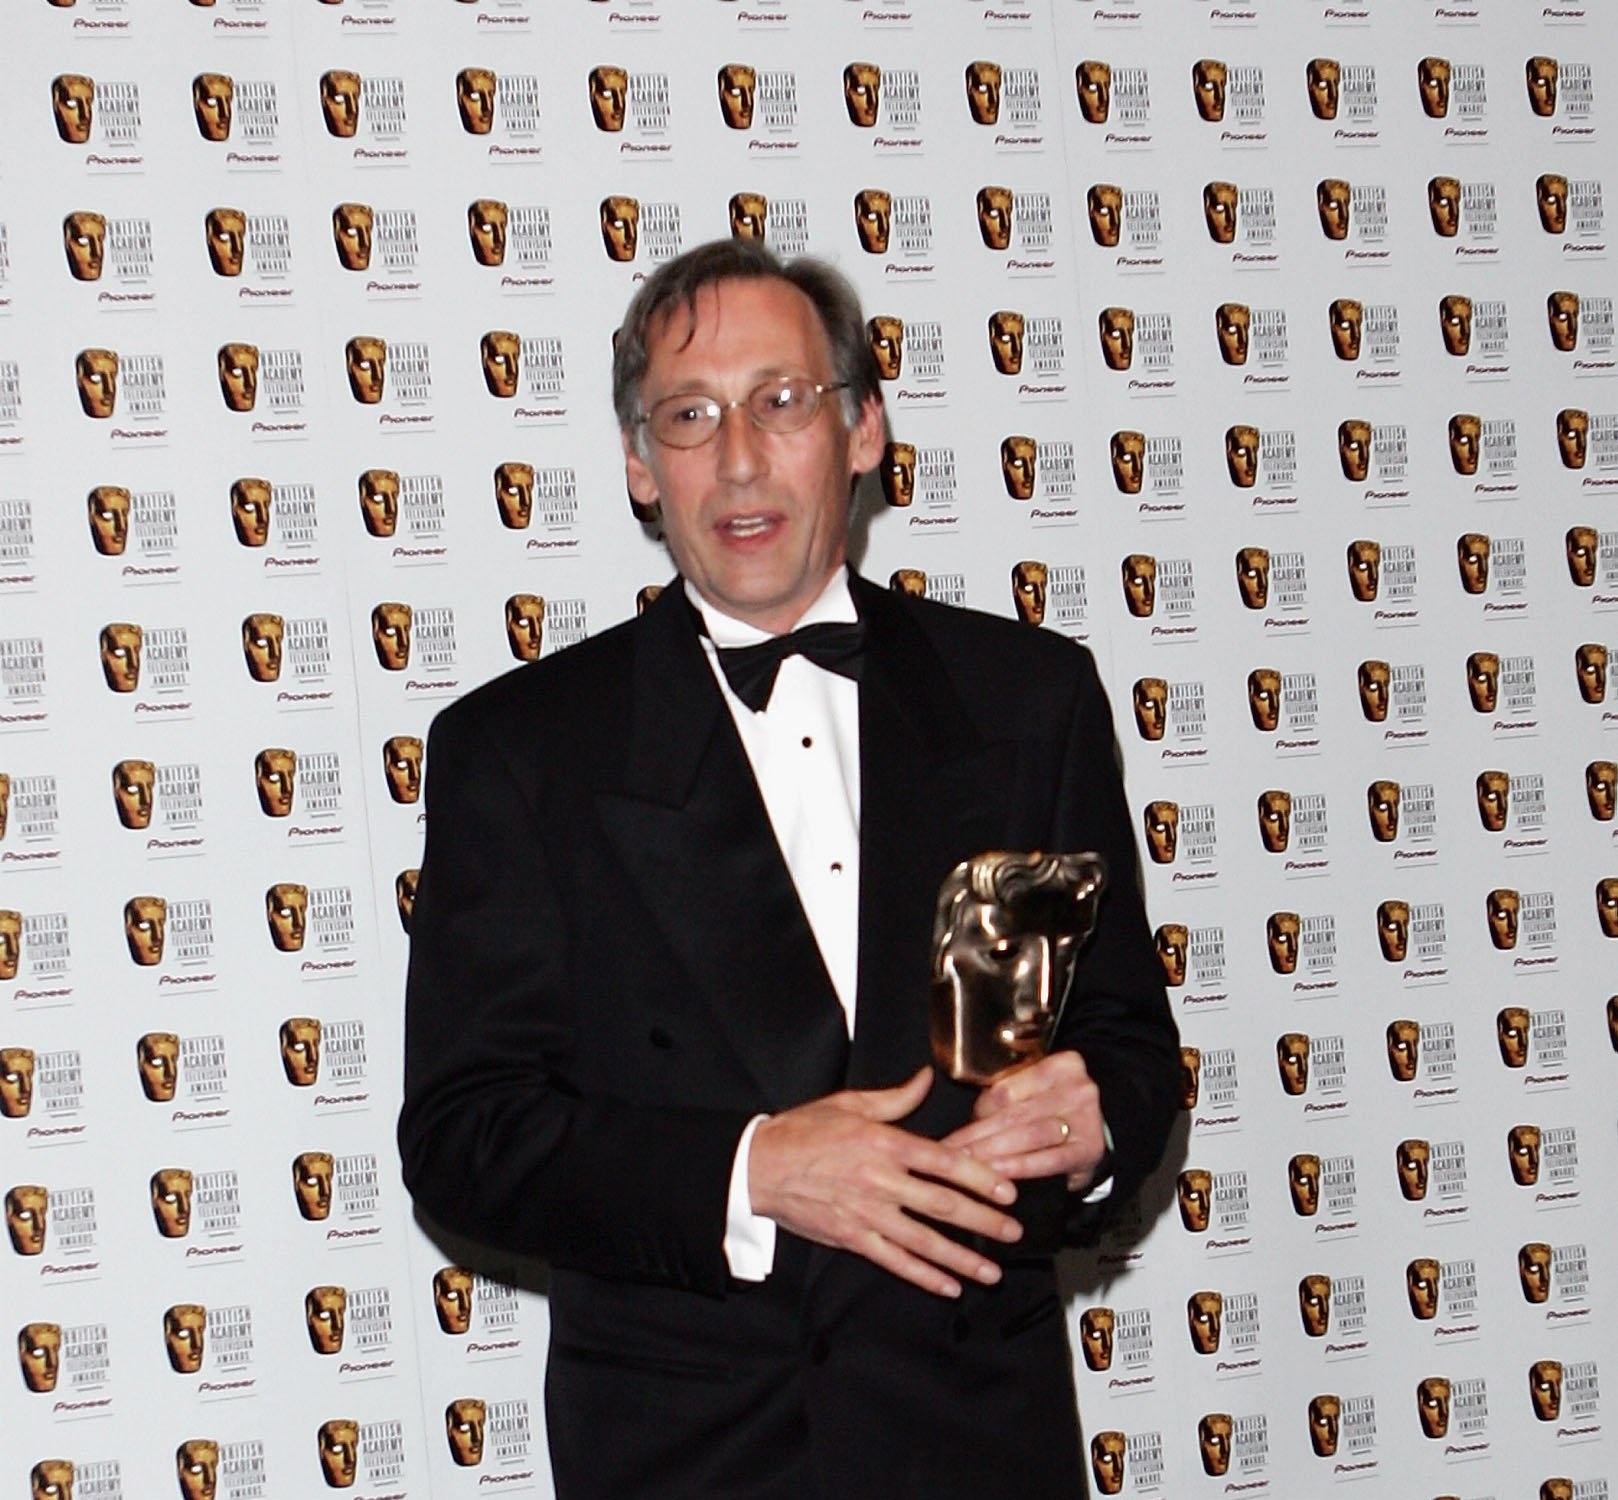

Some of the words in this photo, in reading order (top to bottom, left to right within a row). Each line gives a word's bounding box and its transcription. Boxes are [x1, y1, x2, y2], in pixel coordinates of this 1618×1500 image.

[362, 80, 404, 94] BRITISH
[629, 75, 668, 89] BRITISH
[96, 84, 139, 98] BRITISH
[631, 90, 668, 102] ACADEMY
[98, 99, 139, 112] ACADEMY
[364, 94, 404, 107] ACADEMY
[509, 209, 549, 223] BRITISH
[248, 218, 289, 232] BRITISH
[511, 223, 550, 236] ACADEMY
[250, 232, 289, 245] ACADEMY
[522, 339, 562, 354] BRITISH
[260, 352, 302, 366] BRITISH
[524, 354, 562, 367] ACADEMY
[262, 367, 302, 380] ACADEMY
[401, 477, 442, 492] BRITISH
[132, 493, 175, 509] BRITISH
[403, 492, 443, 506] ACADEMY
[134, 509, 175, 523] ACADEMY
[285, 620, 328, 636] BRITISH
[288, 635, 328, 650] ACADEMY
[157, 765, 200, 782] BRITISH
[159, 781, 200, 796] ACADEMY
[322, 1022, 364, 1039] BRITISH
[325, 1037, 364, 1053] ACADEMY
[194, 1172, 238, 1190] BRITISH
[197, 1187, 238, 1204] ACADEMY
[348, 1289, 389, 1307] BRITISH
[350, 1304, 389, 1321] ACADEMY
[487, 1401, 528, 1419] BRITISH
[489, 1416, 528, 1433] ACADEMY
[220, 1441, 263, 1461] BRITISH
[223, 1457, 264, 1474] ACADEMY
